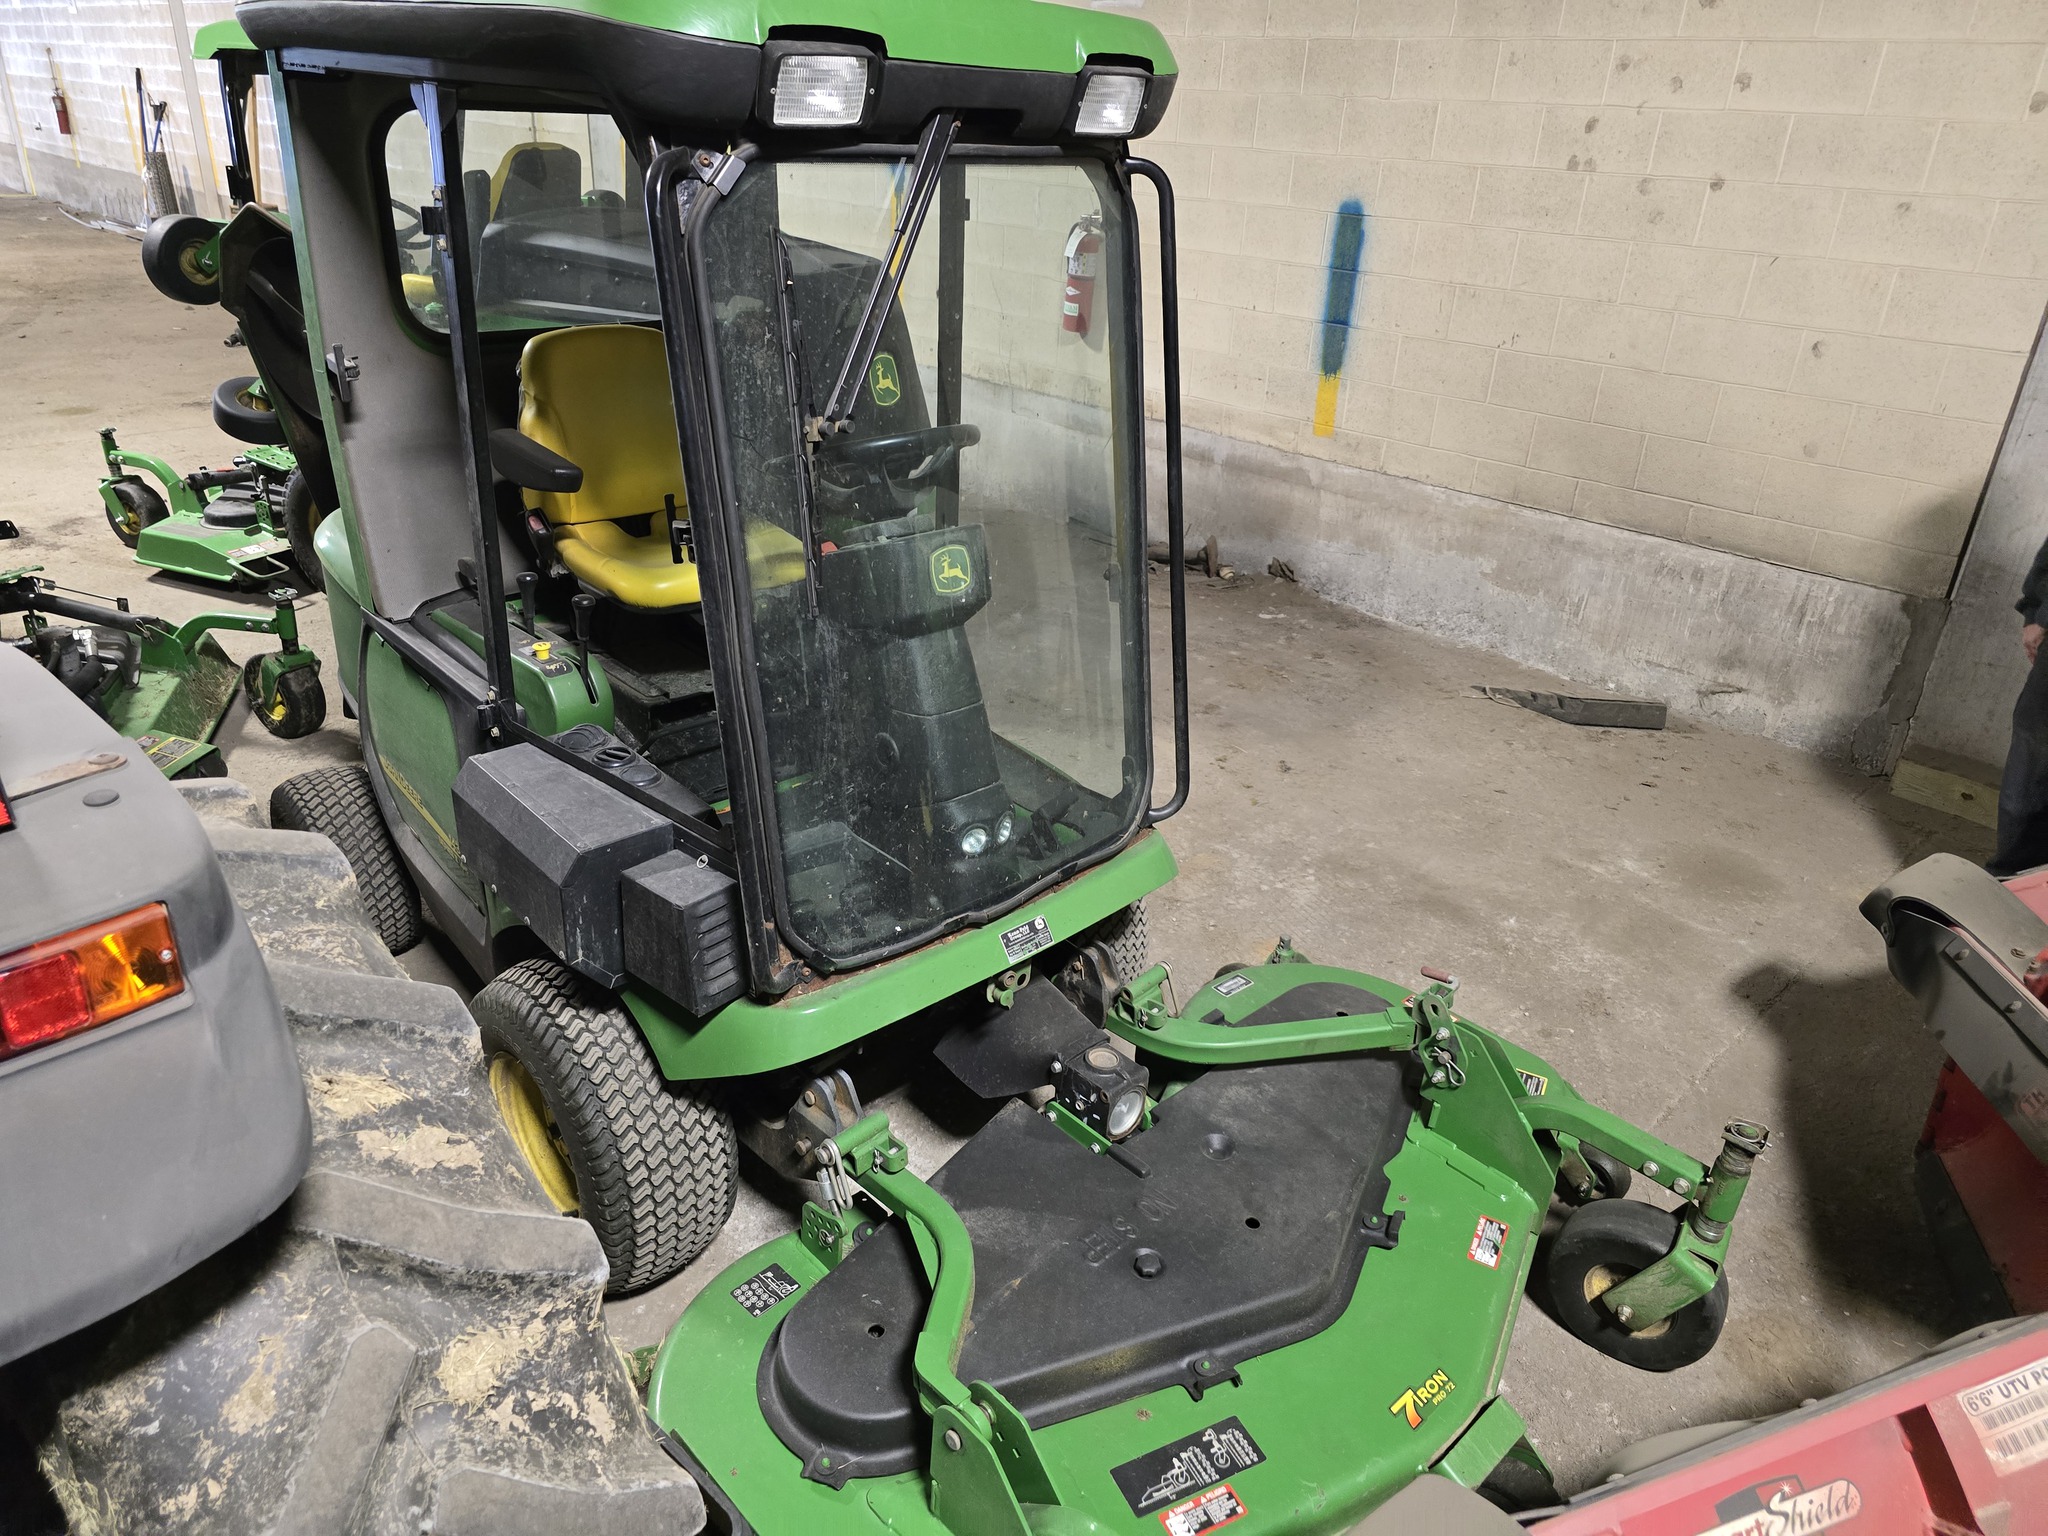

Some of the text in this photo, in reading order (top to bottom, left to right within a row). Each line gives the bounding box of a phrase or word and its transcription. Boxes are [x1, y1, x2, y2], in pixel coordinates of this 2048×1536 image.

[1431, 1381, 1456, 1406] PRO 72
[1996, 1374, 2030, 1399] UTV
[1765, 1480, 1852, 1536] Shield
